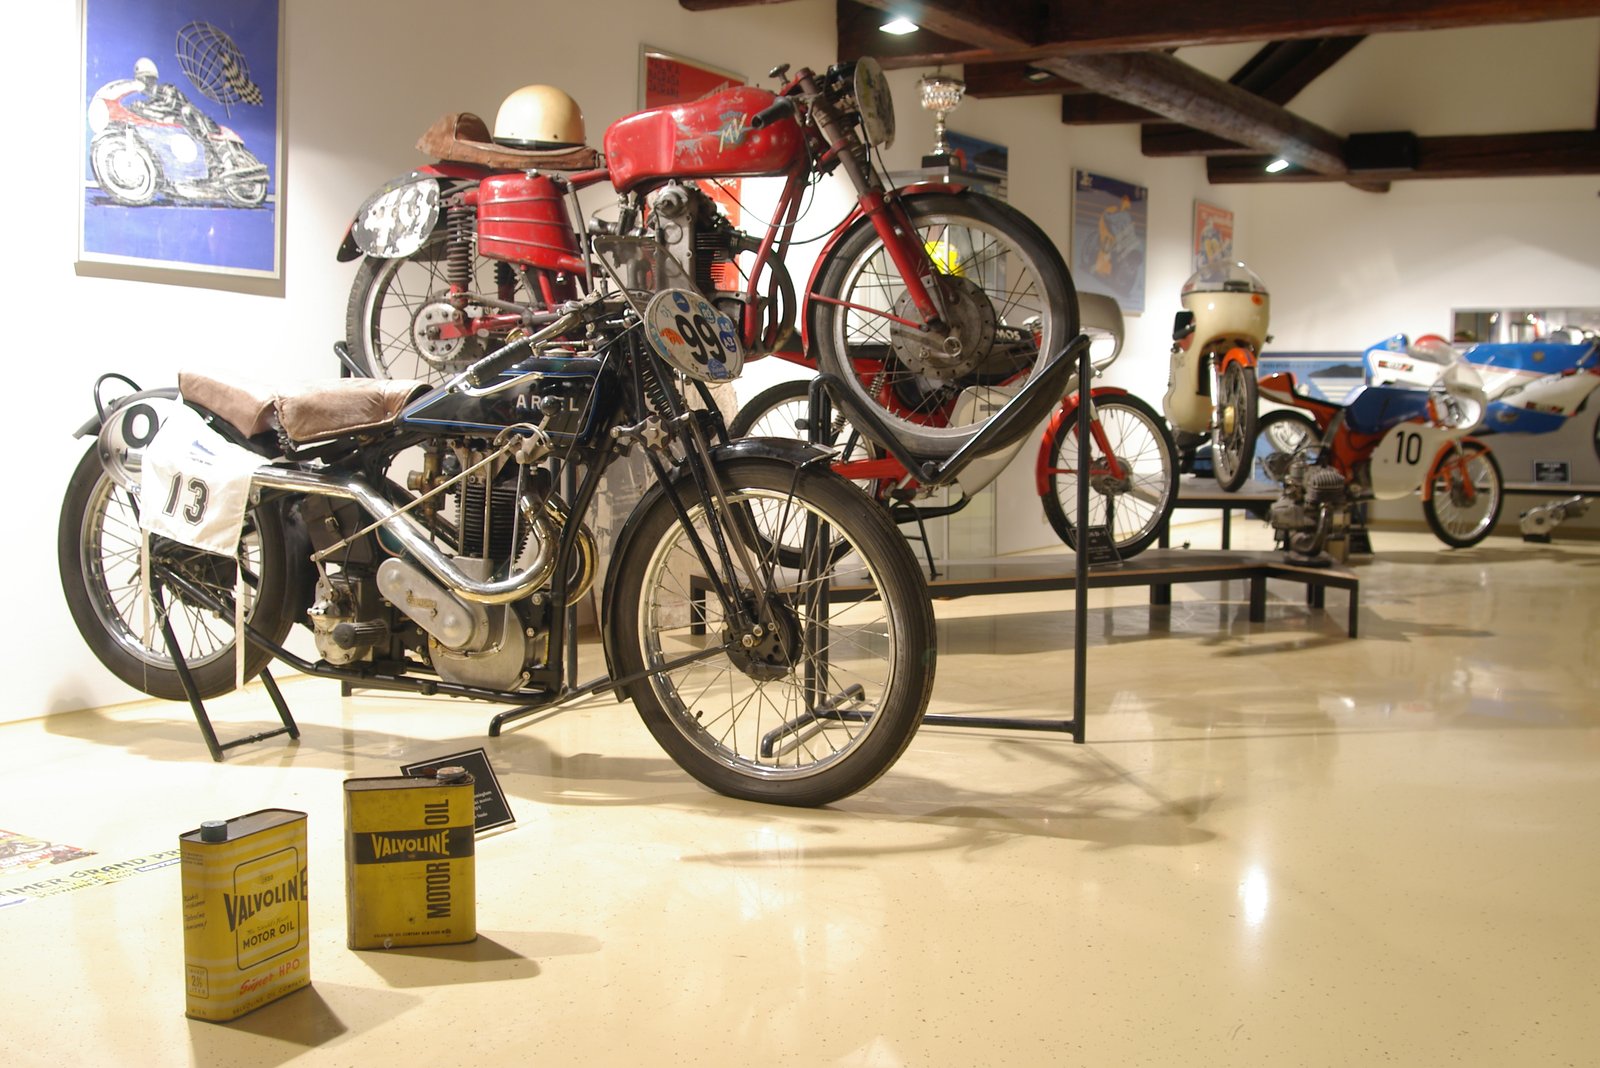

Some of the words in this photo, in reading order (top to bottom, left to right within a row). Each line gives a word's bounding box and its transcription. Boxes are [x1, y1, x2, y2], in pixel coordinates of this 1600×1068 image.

[675, 314, 726, 365] 99
[996, 329, 1021, 341] MOS
[516, 394, 579, 412] ARL
[1396, 431, 1422, 465] 10
[162, 471, 210, 526] 13
[424, 799, 450, 825] OIL
[371, 829, 450, 859] VALVOLINE
[69, 858, 146, 879] GRAND
[223, 865, 308, 932] VALVOLINE
[426, 862, 451, 919] MOTOR
[243, 928, 276, 950] MOTOR
[279, 921, 295, 935] OIL
